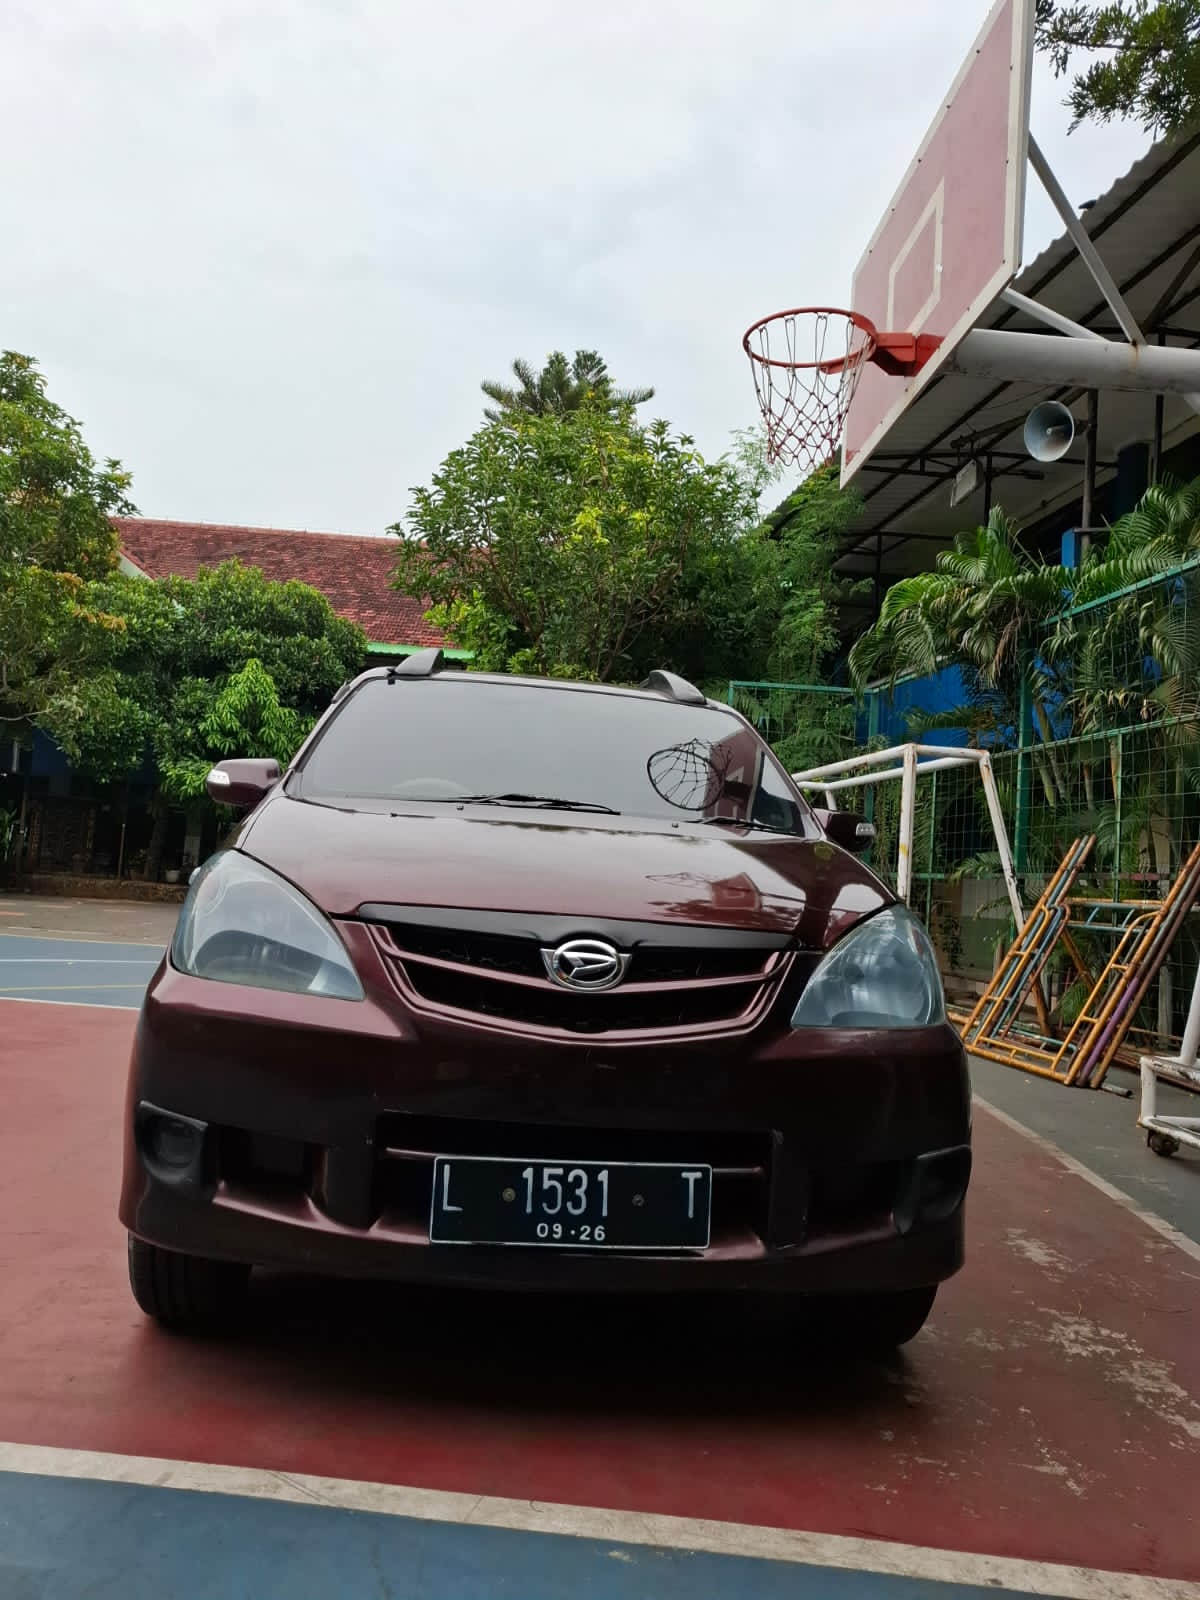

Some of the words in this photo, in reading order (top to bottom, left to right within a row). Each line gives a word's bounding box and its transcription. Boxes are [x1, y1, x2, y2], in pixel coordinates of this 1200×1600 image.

[442, 1164, 463, 1211] L
[522, 1167, 609, 1217] 1531
[681, 1171, 702, 1218] T
